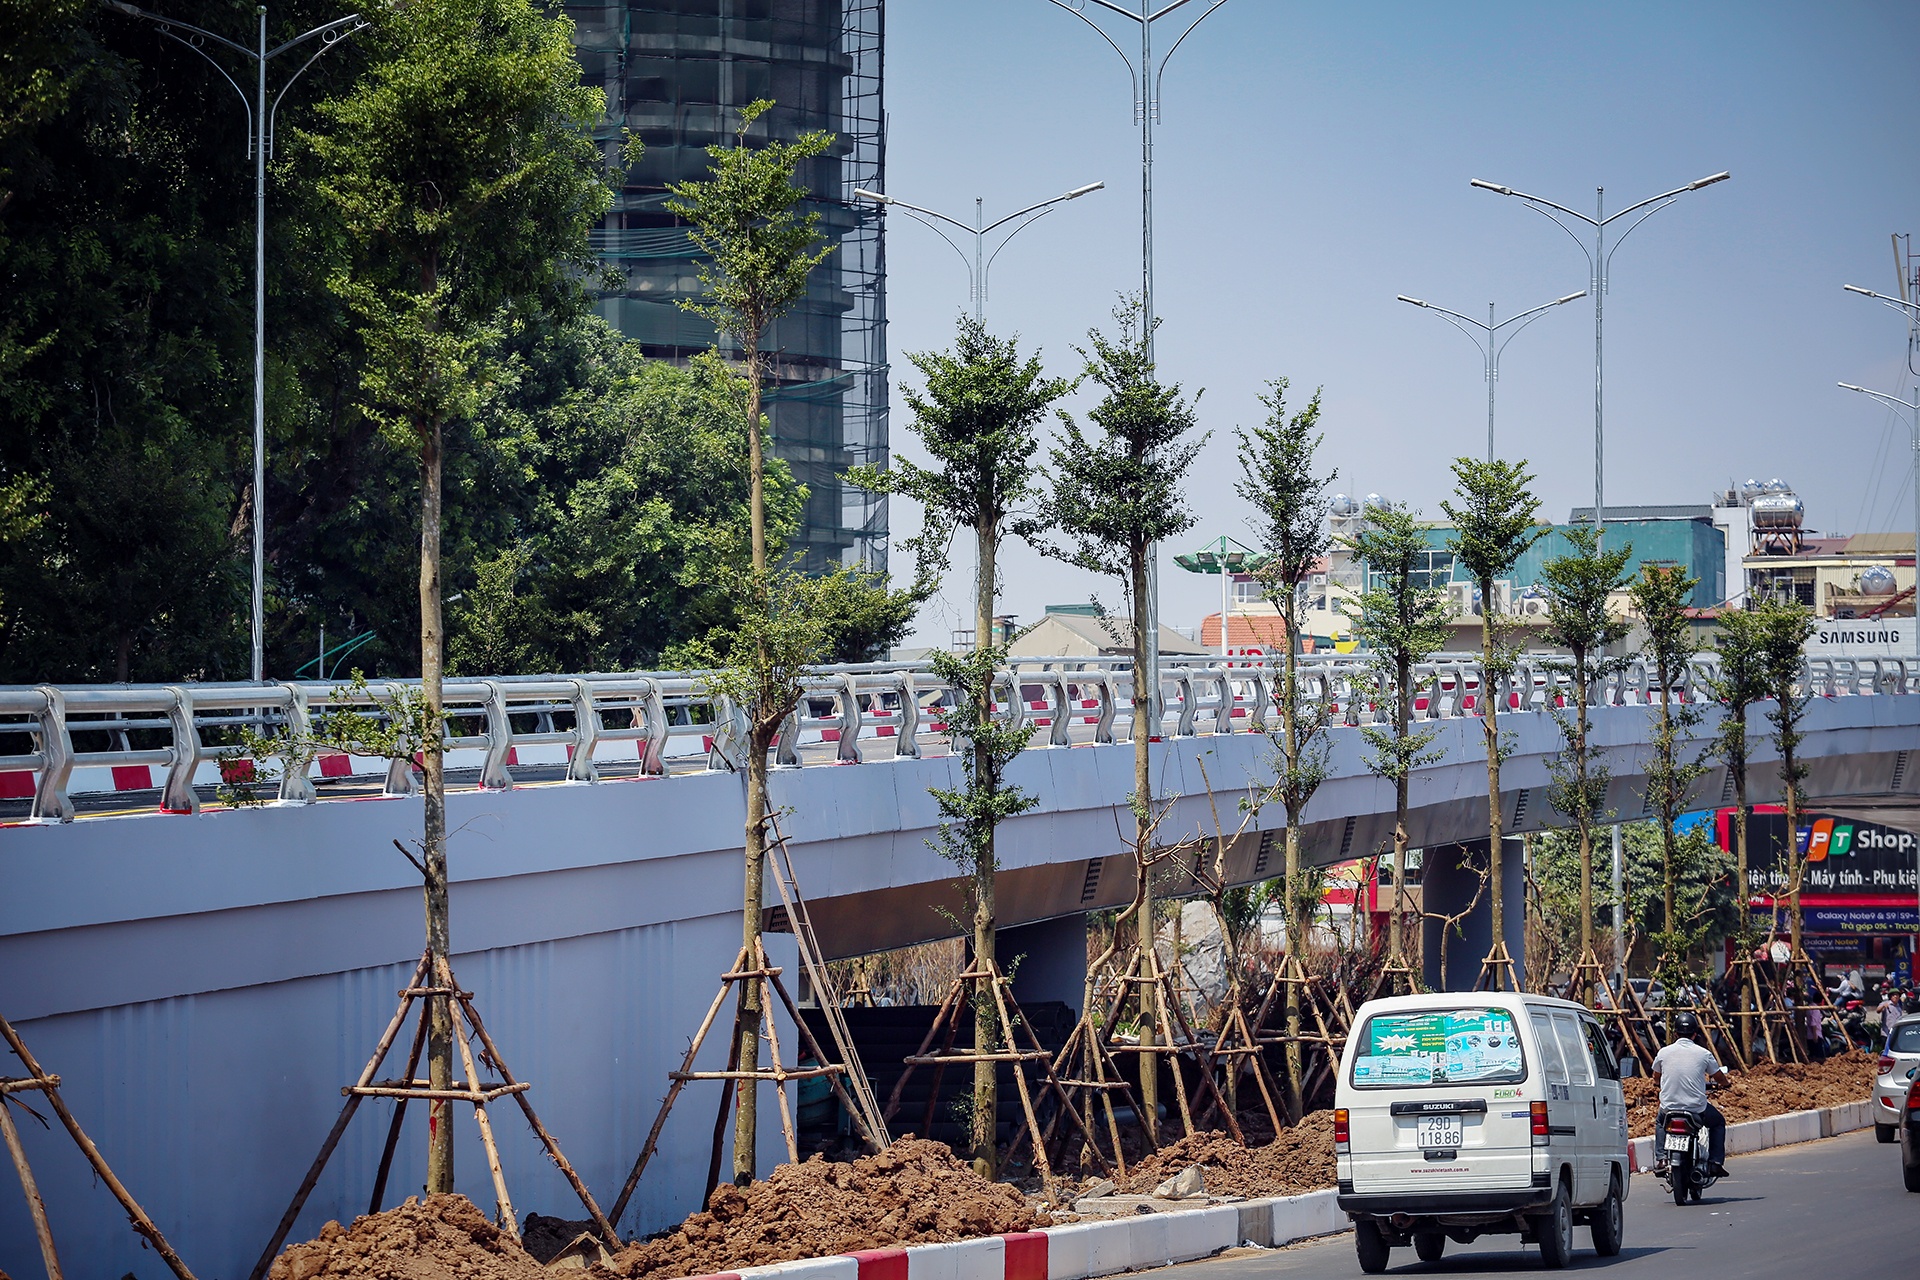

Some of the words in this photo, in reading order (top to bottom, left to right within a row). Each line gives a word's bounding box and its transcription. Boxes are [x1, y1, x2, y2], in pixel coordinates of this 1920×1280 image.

[1820, 630, 1900, 644] SAMSUNG
[1748, 869, 1767, 889] iện
[1811, 870, 1836, 889] Máy
[1839, 869, 1863, 885] tính
[1873, 870, 1896, 889] Phụ
[1816, 912, 1848, 921] Galaxy
[1855, 922, 1873, 931] góp
[1428, 1116, 1451, 1131] 29D
[1420, 1131, 1460, 1146] 118.86
